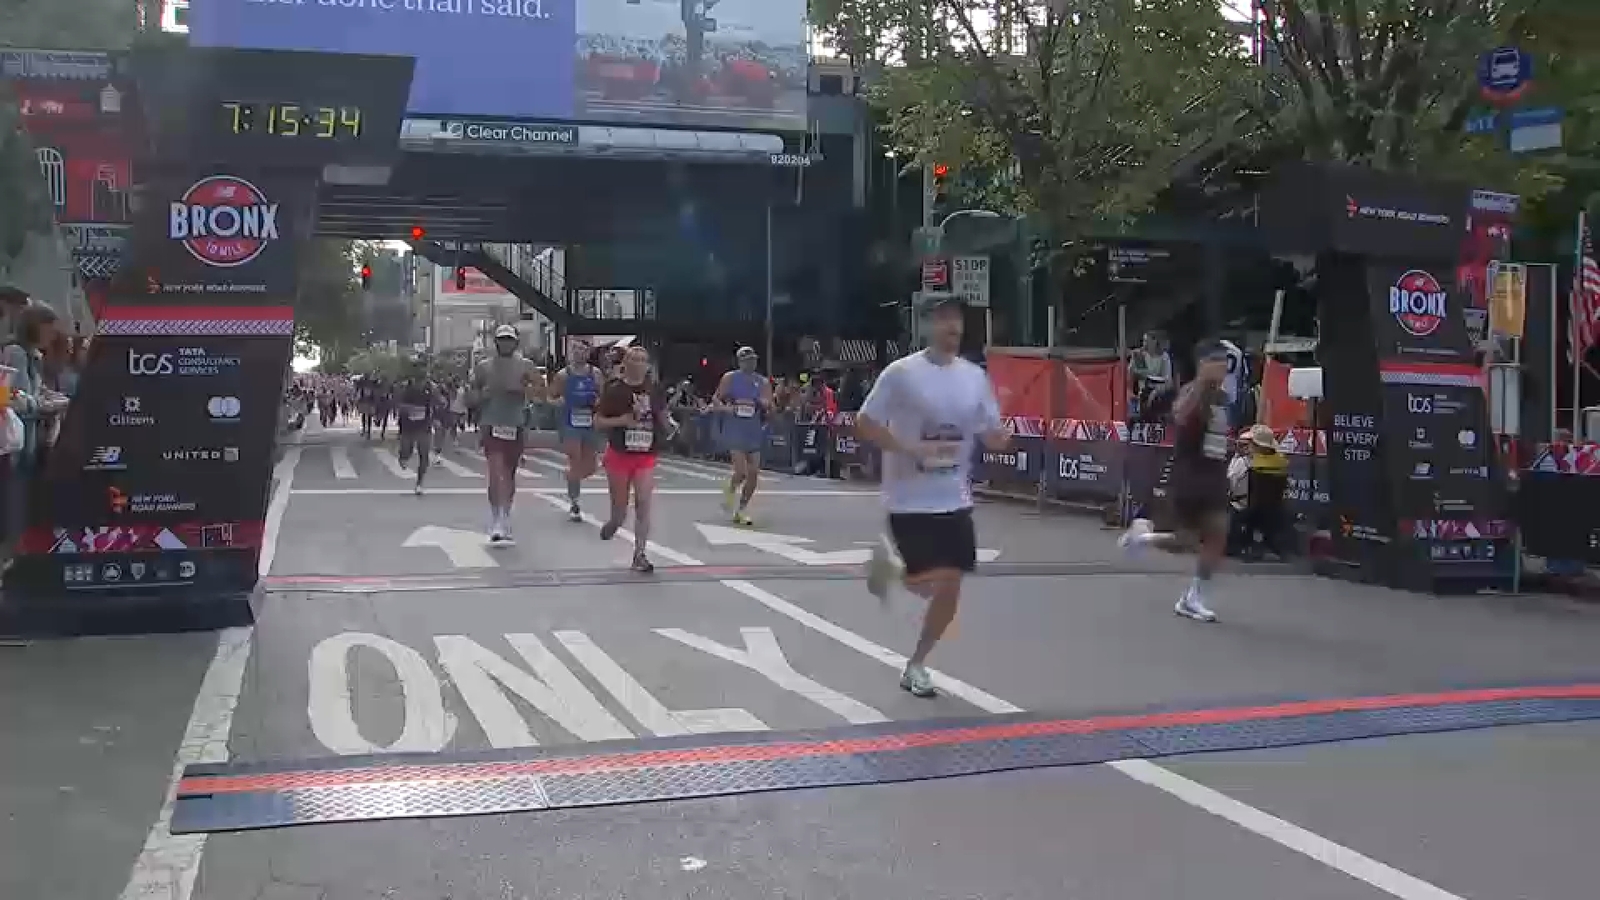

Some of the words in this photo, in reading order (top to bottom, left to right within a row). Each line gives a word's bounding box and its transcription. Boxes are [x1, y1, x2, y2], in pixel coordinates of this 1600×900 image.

[481, 0, 549, 19] said.
[467, 124, 509, 140] Clear
[511, 126, 573, 142] Channel
[169, 202, 279, 240] BRONX
[954, 259, 987, 270] STOP
[1389, 286, 1447, 318] BRONX
[129, 346, 174, 374] tcs
[178, 347, 206, 356] TATA
[1407, 393, 1431, 413] tcs
[1333, 414, 1375, 428] BELIEVE
[1346, 431, 1380, 446] EVERY
[162, 450, 221, 460] UNITED
[982, 452, 1016, 466] UNITED
[1344, 448, 1371, 461] STEP
[1059, 453, 1078, 479] tcs
[307, 626, 891, 756] ONLY
